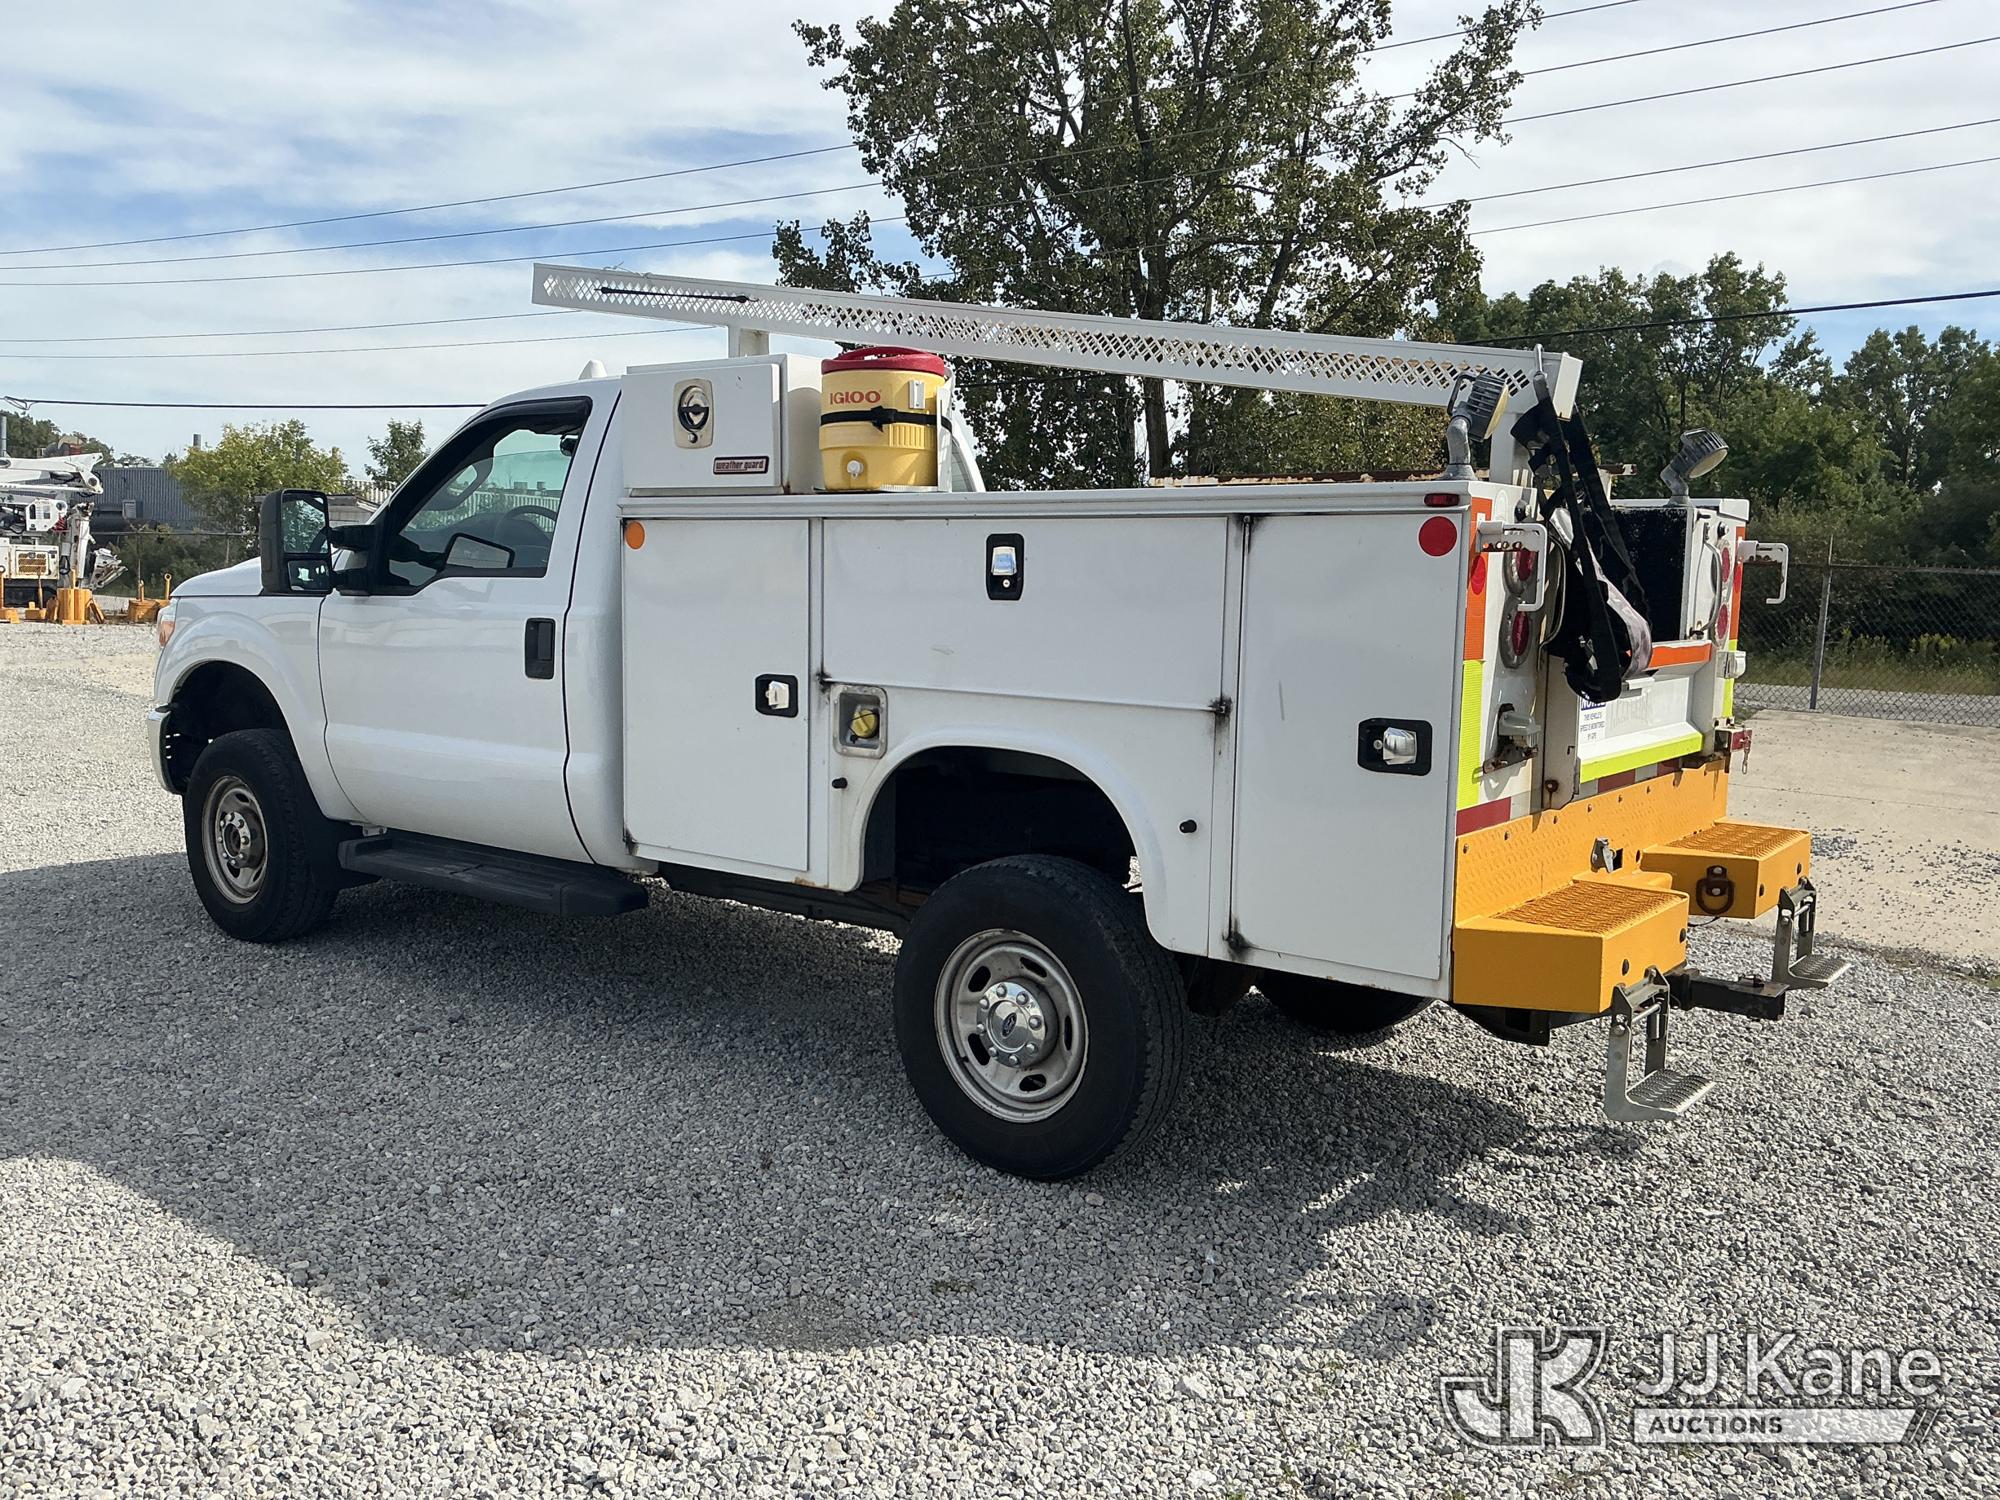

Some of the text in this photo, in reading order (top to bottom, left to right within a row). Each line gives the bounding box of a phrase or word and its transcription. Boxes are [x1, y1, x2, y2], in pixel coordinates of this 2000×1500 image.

[829, 390, 881, 405] IGLOO
[715, 460, 764, 471] weather guard
